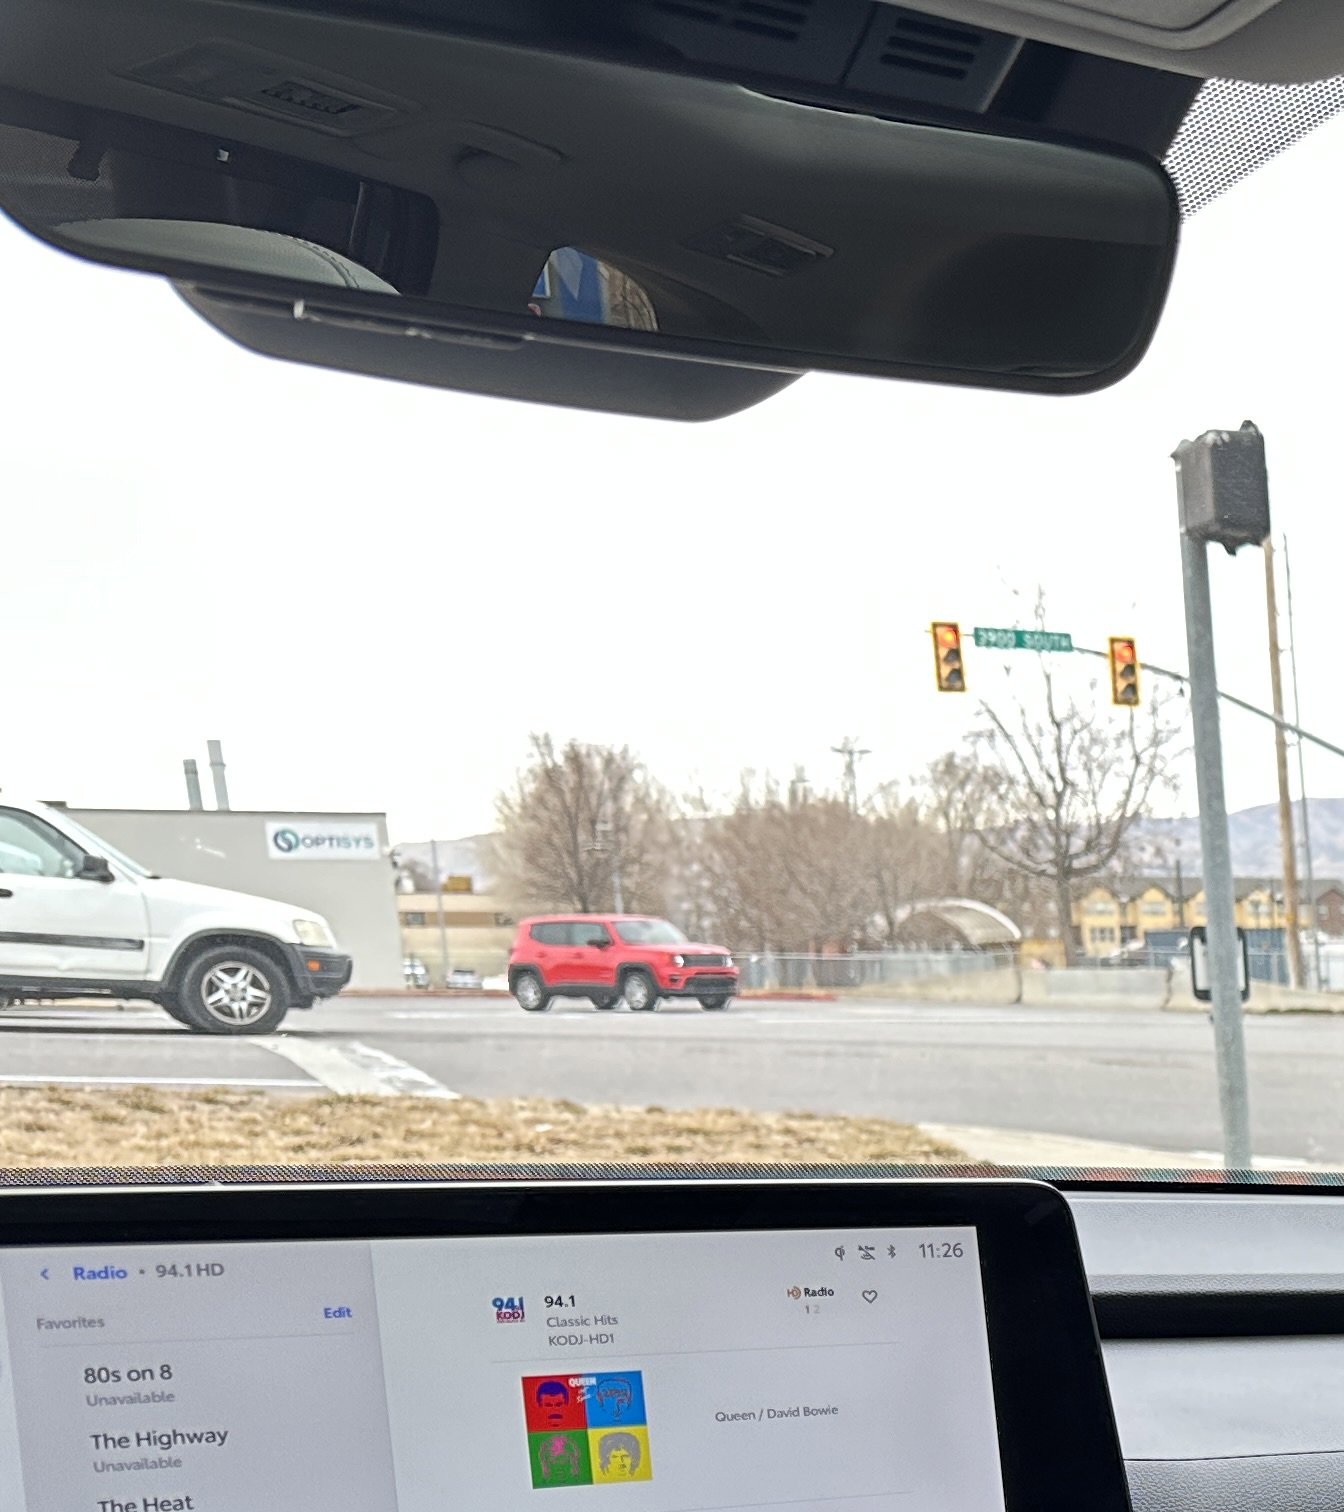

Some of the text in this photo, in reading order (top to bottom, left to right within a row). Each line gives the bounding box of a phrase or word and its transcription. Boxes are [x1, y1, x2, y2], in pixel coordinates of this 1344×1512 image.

[301, 836, 375, 849] OPTISYS
[918, 1242, 965, 1259] 11:26
[73, 1265, 128, 1281] Radio
[803, 1286, 834, 1298] Radio
[543, 1295, 576, 1308] 94.1
[323, 1306, 352, 1320] Edit
[546, 1314, 618, 1328] Classic Hits
[36, 1315, 105, 1331] Favorites
[548, 1333, 615, 1347] KODJ-HD1
[83, 1363, 173, 1385] 80s on 8
[86, 1389, 175, 1408] Unavailable
[715, 1409, 756, 1423] Queen
[766, 1405, 800, 1420] David
[802, 1403, 839, 1418] Bowie
[90, 1426, 229, 1450] The Highway
[93, 1455, 182, 1474] Unavailable
